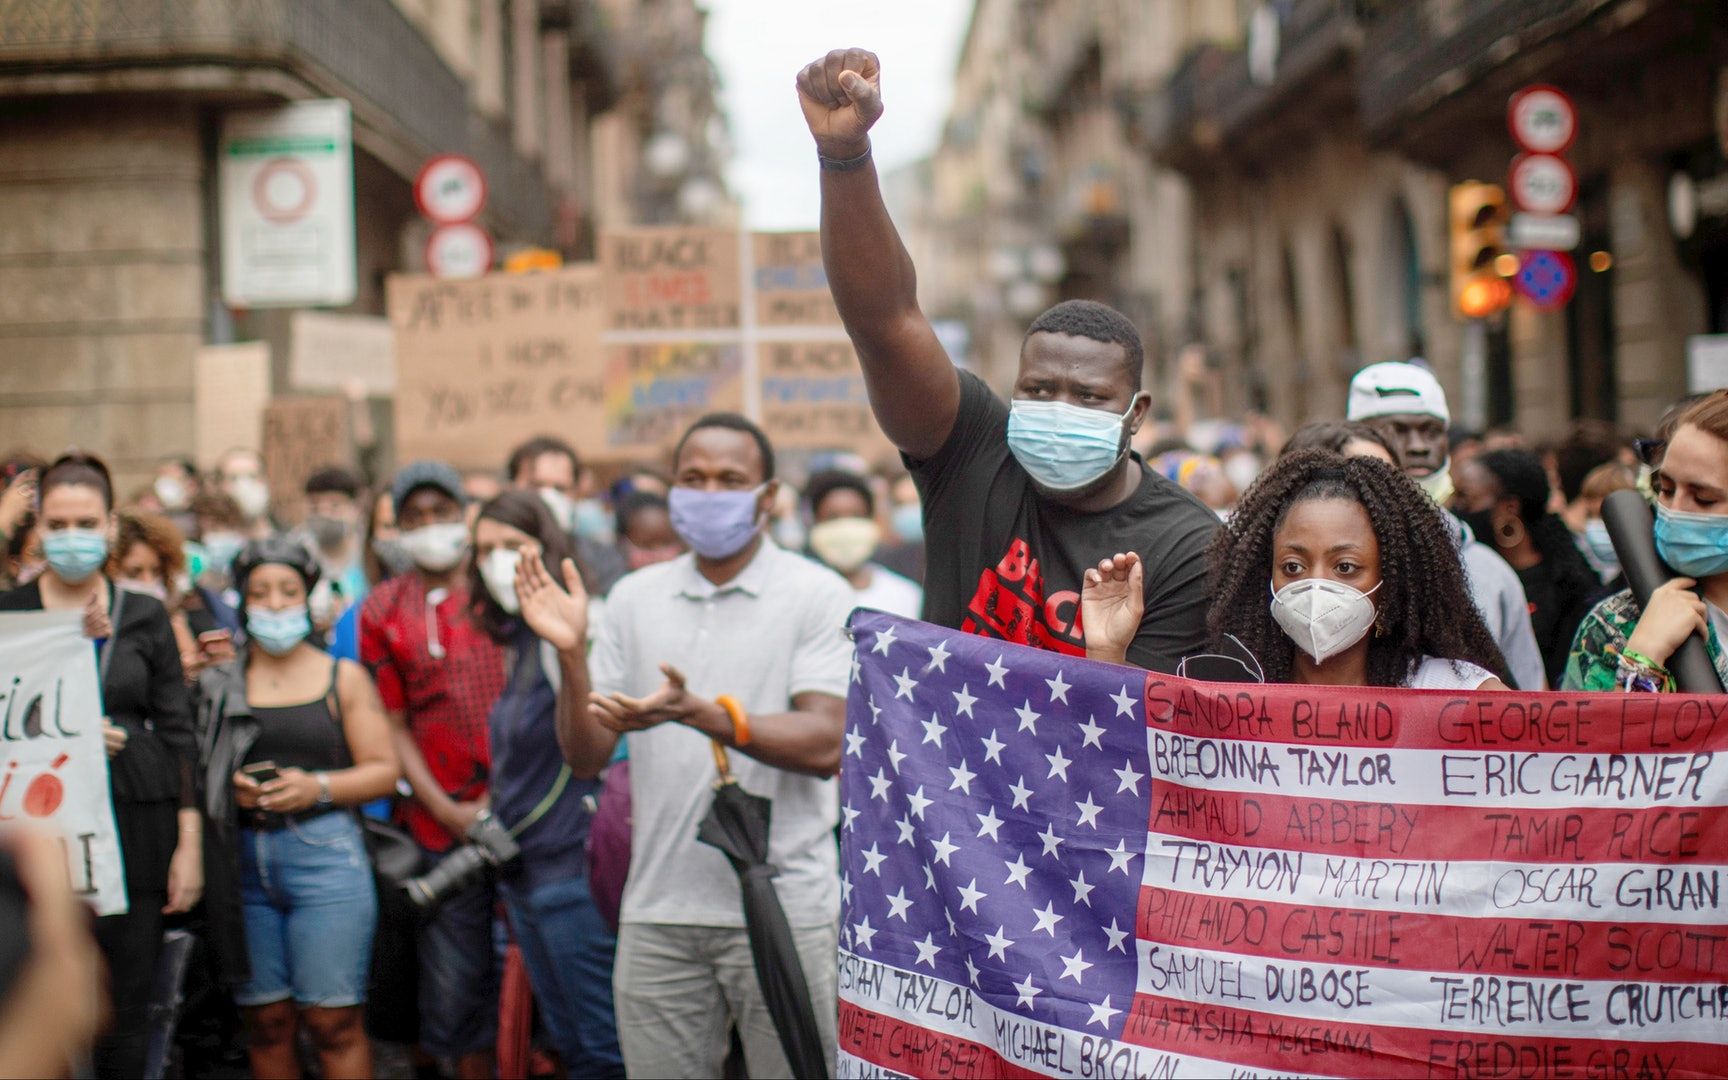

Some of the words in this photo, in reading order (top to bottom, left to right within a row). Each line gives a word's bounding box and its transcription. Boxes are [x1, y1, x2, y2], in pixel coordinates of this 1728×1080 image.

[1148, 680, 1273, 737] SANDRA
[1291, 699, 1394, 742] BLAND
[1437, 699, 1592, 747] GEORGE
[1154, 731, 1280, 787] BREONNA
[1286, 746, 1396, 786] TAYLOR
[1441, 753, 1541, 798] ERIC
[1550, 750, 1715, 801] GARNER
[1153, 788, 1264, 838] AHMAUD
[1283, 802, 1420, 854] ARBERY
[1484, 813, 1585, 861] TAMIR
[1606, 811, 1700, 859] RICE
[1160, 839, 1304, 896] TRAYVON
[1318, 857, 1449, 906] MARTIN
[1492, 867, 1602, 910] OSCAR
[1145, 887, 1268, 947] PHILANDO
[1280, 908, 1402, 965] CASTILE
[1455, 920, 1585, 977] WALTER
[1607, 926, 1728, 974] SCOTT
[894, 969, 977, 1029] TAYLOR
[992, 1010, 1073, 1075] MICHAEL
[1080, 1035, 1180, 1079] BROWN
[1149, 945, 1256, 1001] SAMUEL
[1265, 964, 1373, 1010] DUBOSE
[1429, 976, 1591, 1027] TERRENCE
[1130, 999, 1254, 1046] NATASHA
[1428, 1039, 1574, 1079] FREDDIE
